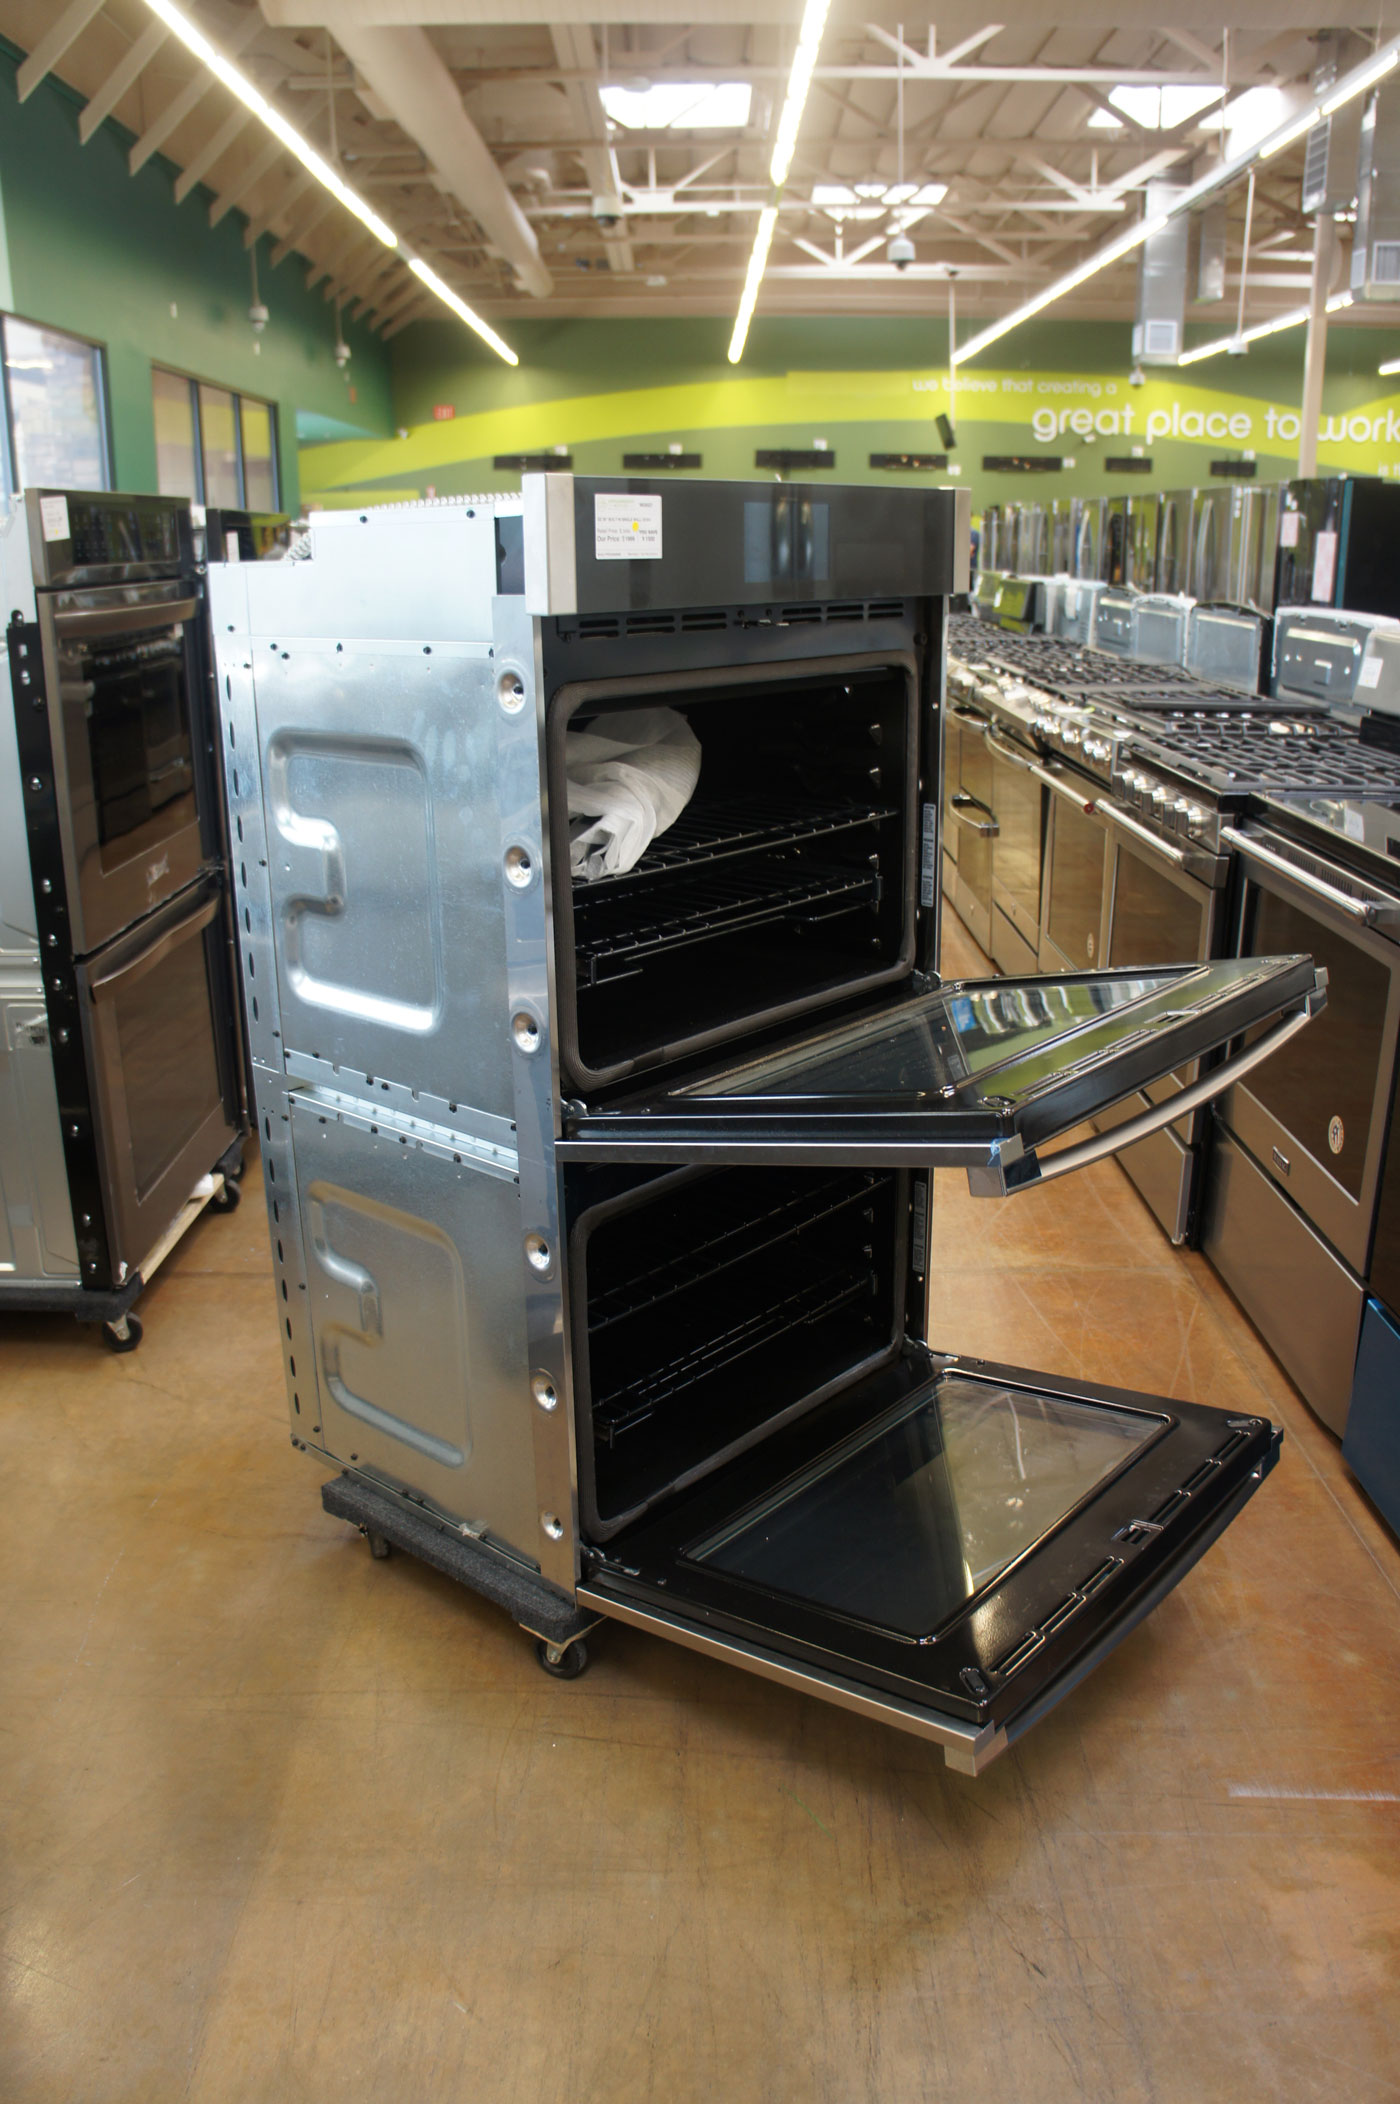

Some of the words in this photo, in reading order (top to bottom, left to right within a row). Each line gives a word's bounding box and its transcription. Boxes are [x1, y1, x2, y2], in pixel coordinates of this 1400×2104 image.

[912, 379, 938, 392] we
[1002, 378, 1032, 393] that
[1037, 379, 1101, 398] creating
[1105, 383, 1118, 395] a
[1032, 403, 1135, 442] great
[1146, 402, 1252, 445] place
[1264, 406, 1301, 440] to
[1317, 408, 1400, 442] work
